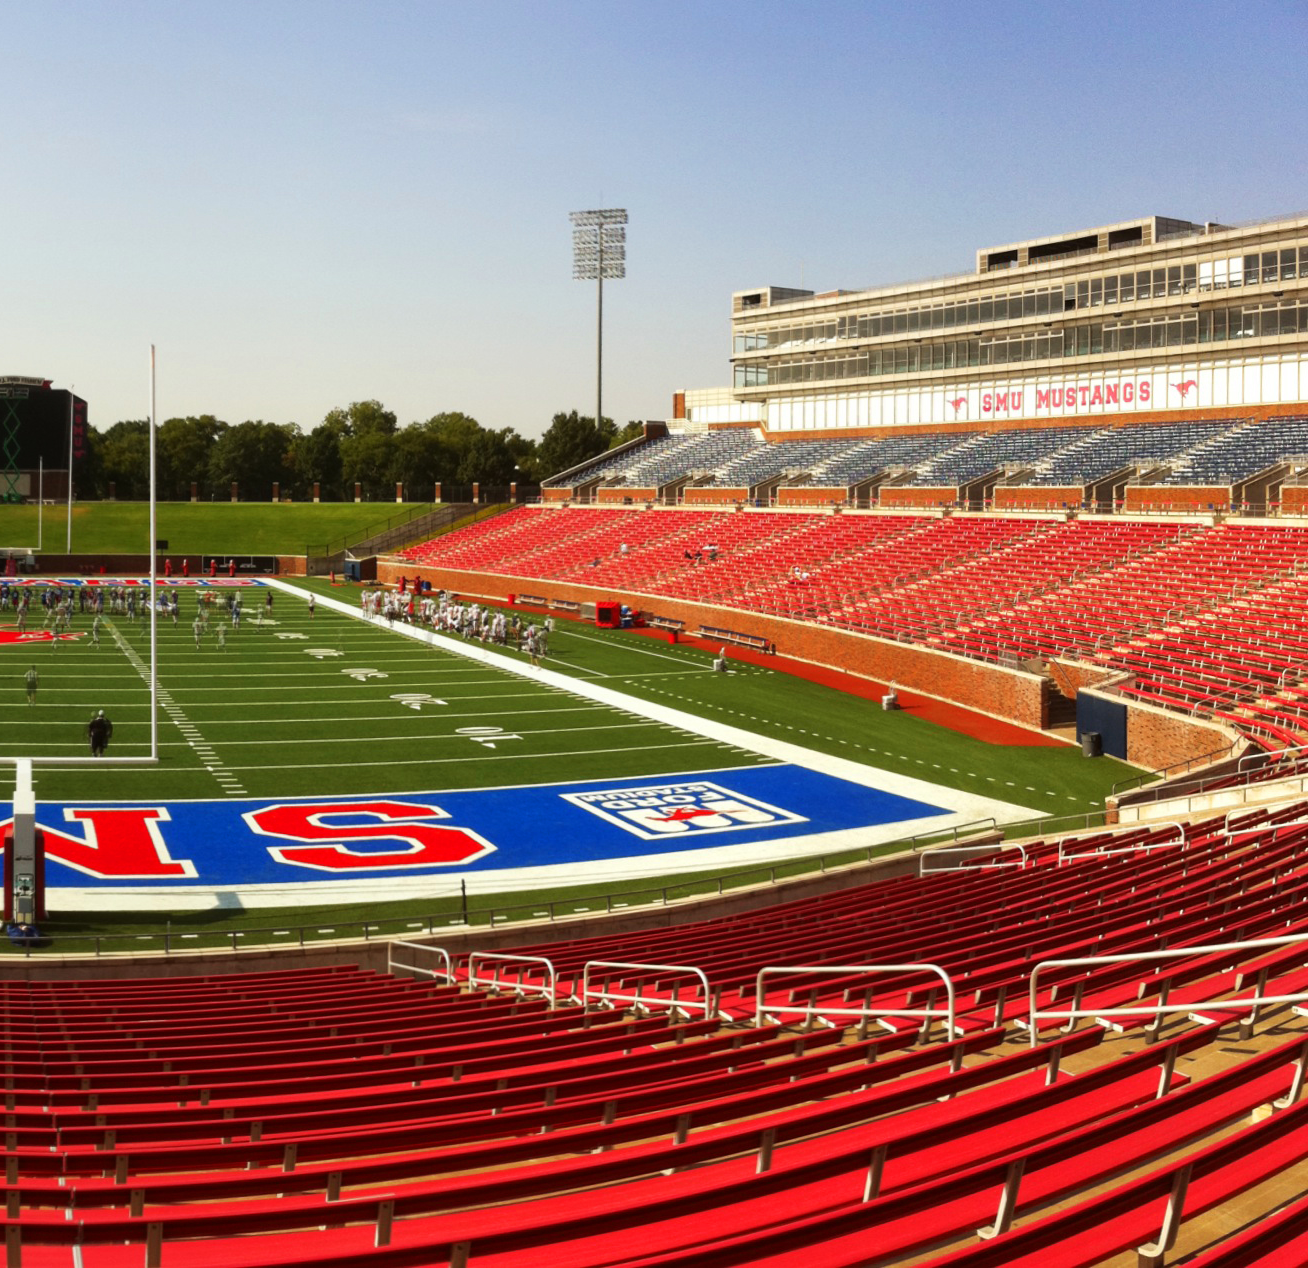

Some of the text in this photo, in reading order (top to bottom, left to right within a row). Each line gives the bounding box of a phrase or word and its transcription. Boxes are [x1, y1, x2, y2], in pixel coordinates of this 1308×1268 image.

[982, 381, 1151, 412] SMU MUSTANGS
[73, 414, 83, 447] SMU
[389, 693, 449, 706] 20
[455, 726, 525, 742] 10
[578, 785, 709, 802] STADIUM
[600, 791, 726, 809] FORD
